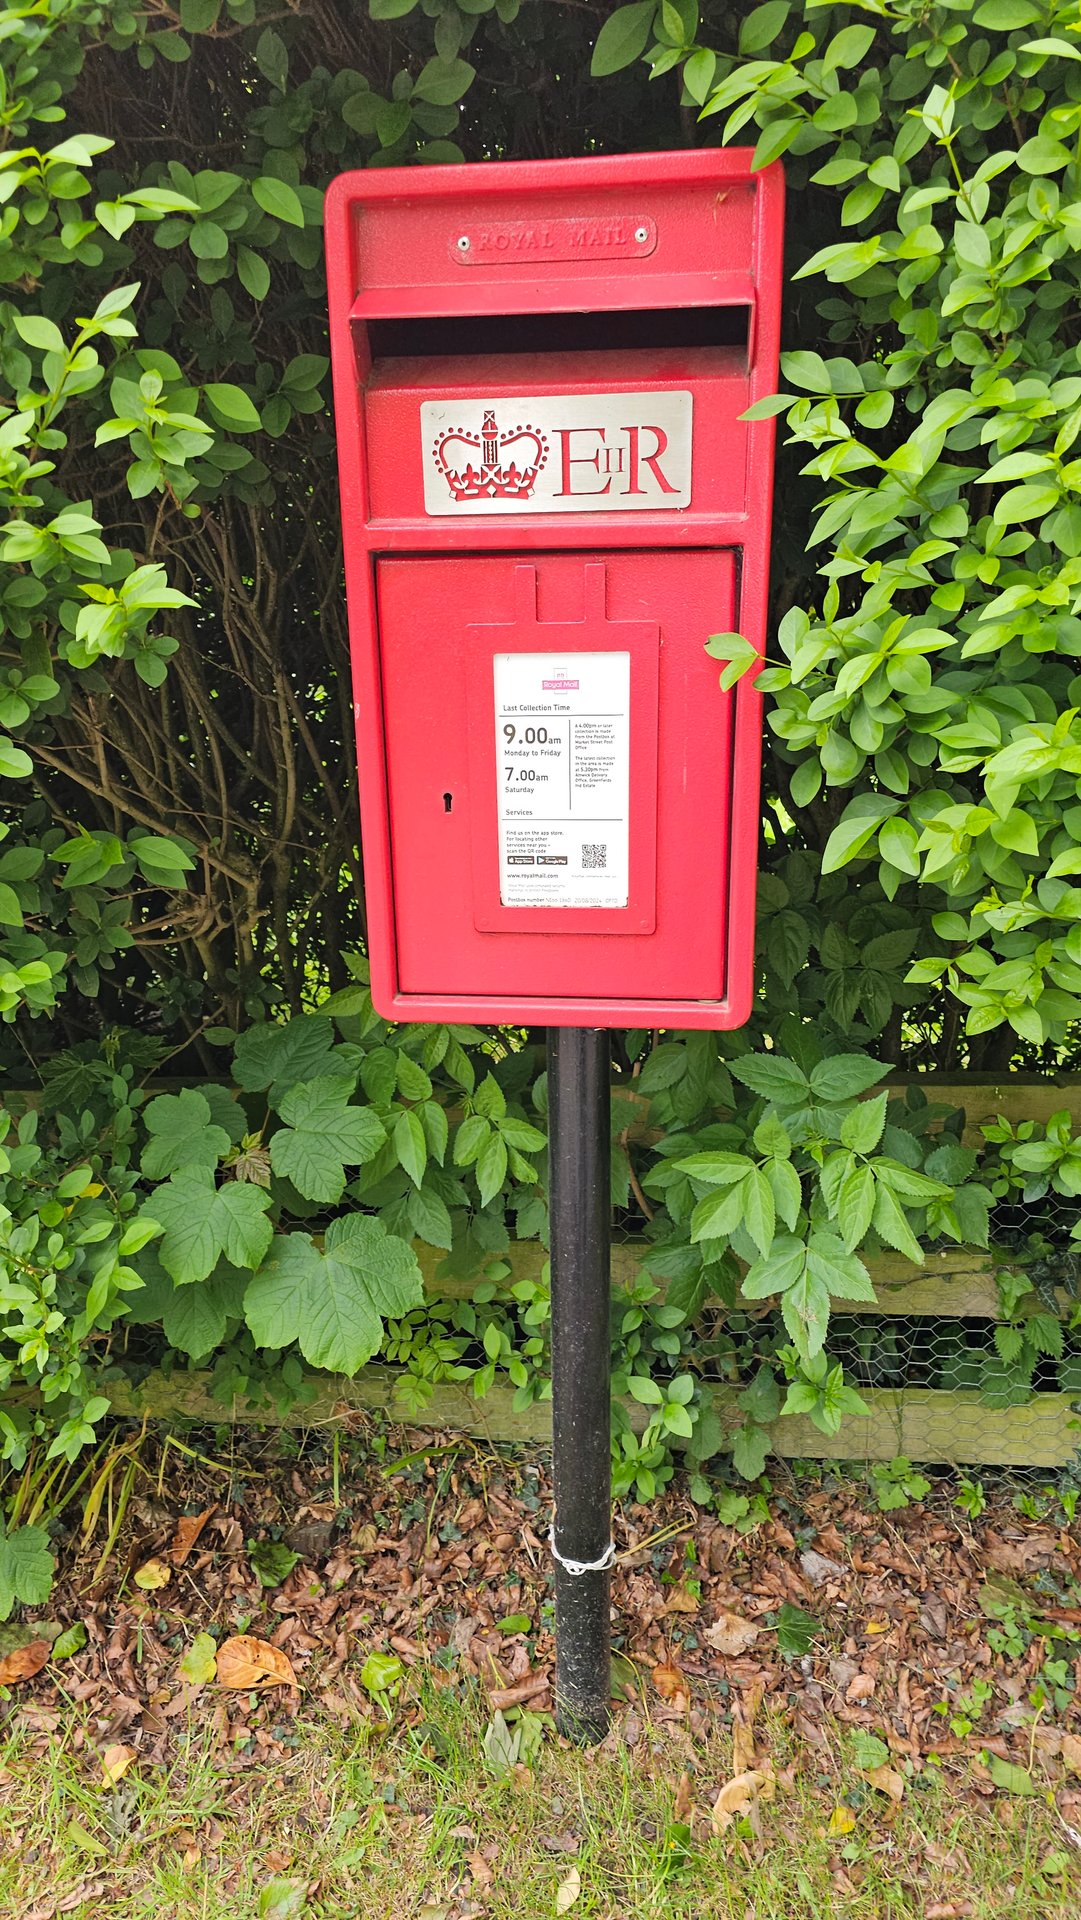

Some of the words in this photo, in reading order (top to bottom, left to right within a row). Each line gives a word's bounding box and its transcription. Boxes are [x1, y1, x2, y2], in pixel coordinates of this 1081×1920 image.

[479, 231, 555, 251] ROYAL
[568, 228, 628, 248] MAIL
[543, 681, 562, 689] Royal
[563, 681, 578, 689] Mail
[503, 724, 562, 744] 9.00am
[505, 767, 548, 781] 7.00am
